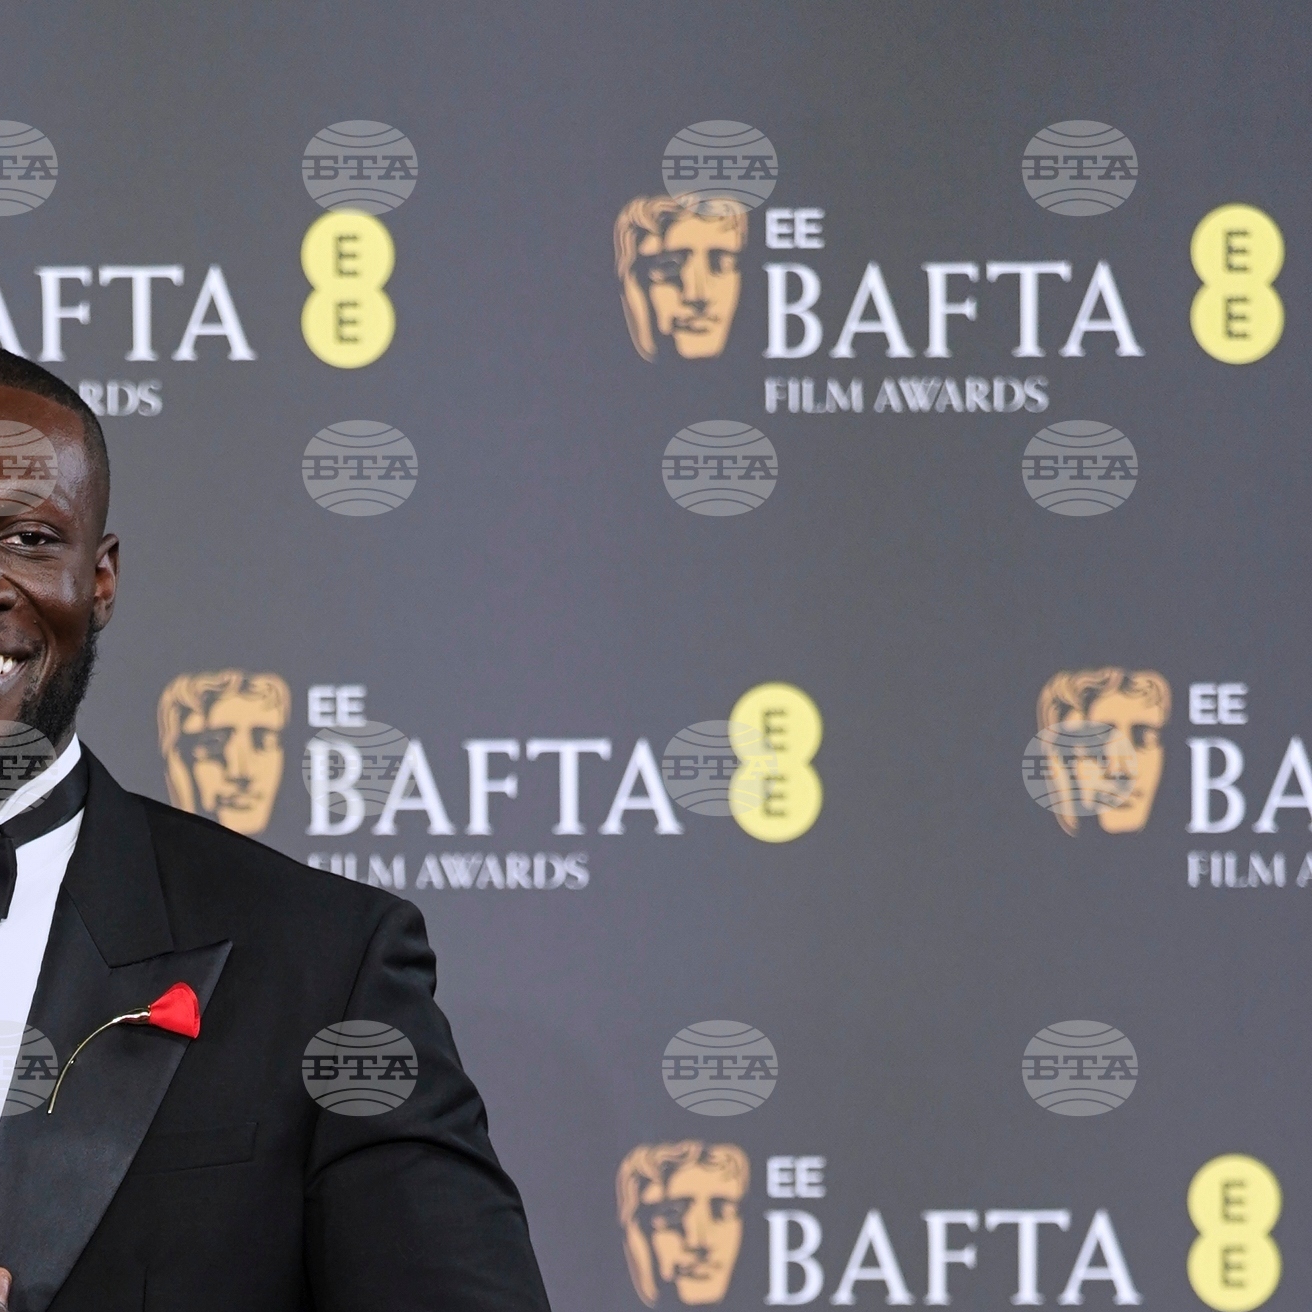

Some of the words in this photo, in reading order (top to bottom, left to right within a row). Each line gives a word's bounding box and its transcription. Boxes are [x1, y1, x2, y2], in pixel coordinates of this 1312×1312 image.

[766, 208, 824, 249] EE
[765, 261, 1143, 358] BAFTA
[79, 380, 163, 416] RDS
[765, 378, 863, 413] FILM
[874, 377, 1048, 412] AWARDS
[308, 685, 367, 727] EE
[1189, 683, 1247, 724] EE
[306, 738, 685, 835] BAFTA
[416, 853, 589, 889] AWARDS
[1188, 852, 1286, 887] FILM
[767, 1156, 825, 1198] EE
[767, 1210, 1140, 1305] BAFTA
